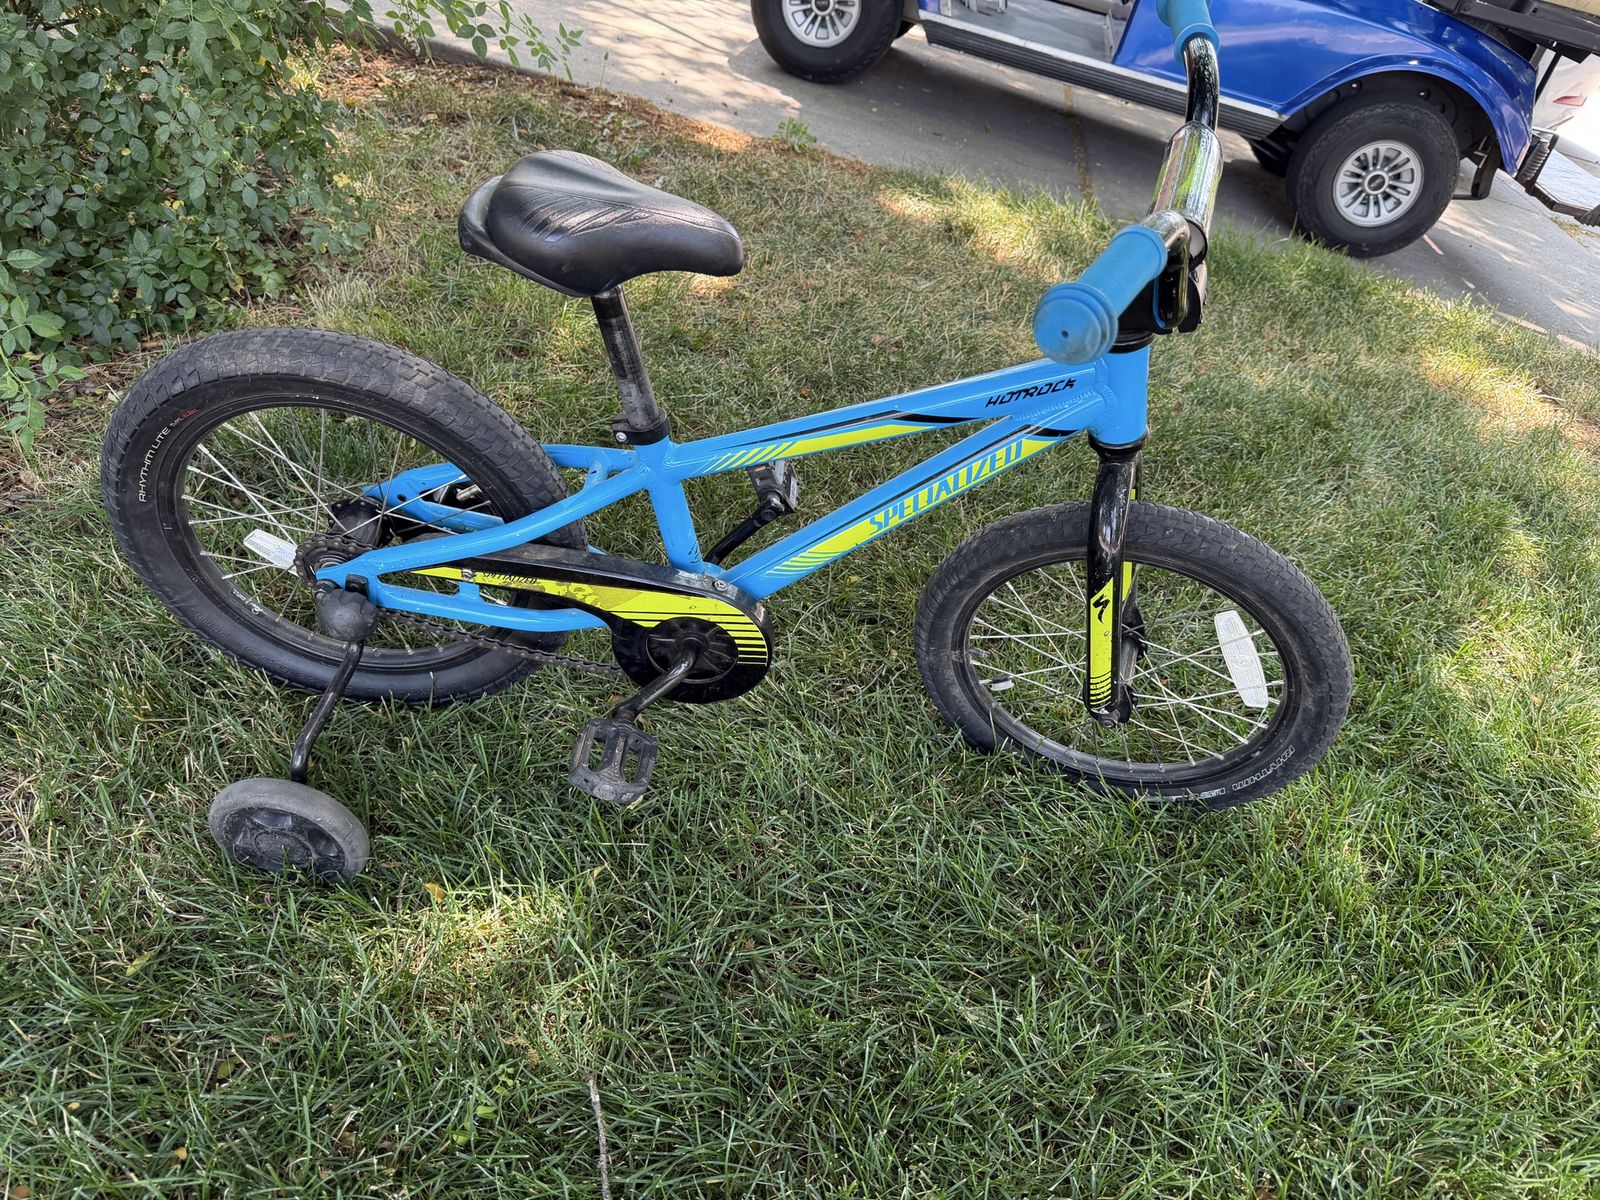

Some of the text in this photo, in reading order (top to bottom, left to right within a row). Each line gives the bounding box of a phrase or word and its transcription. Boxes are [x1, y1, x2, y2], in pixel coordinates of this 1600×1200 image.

[985, 378, 1077, 408] HOTROCK
[138, 427, 171, 503] RHYTHM LITE
[868, 439, 1024, 536] SPECIALIZED
